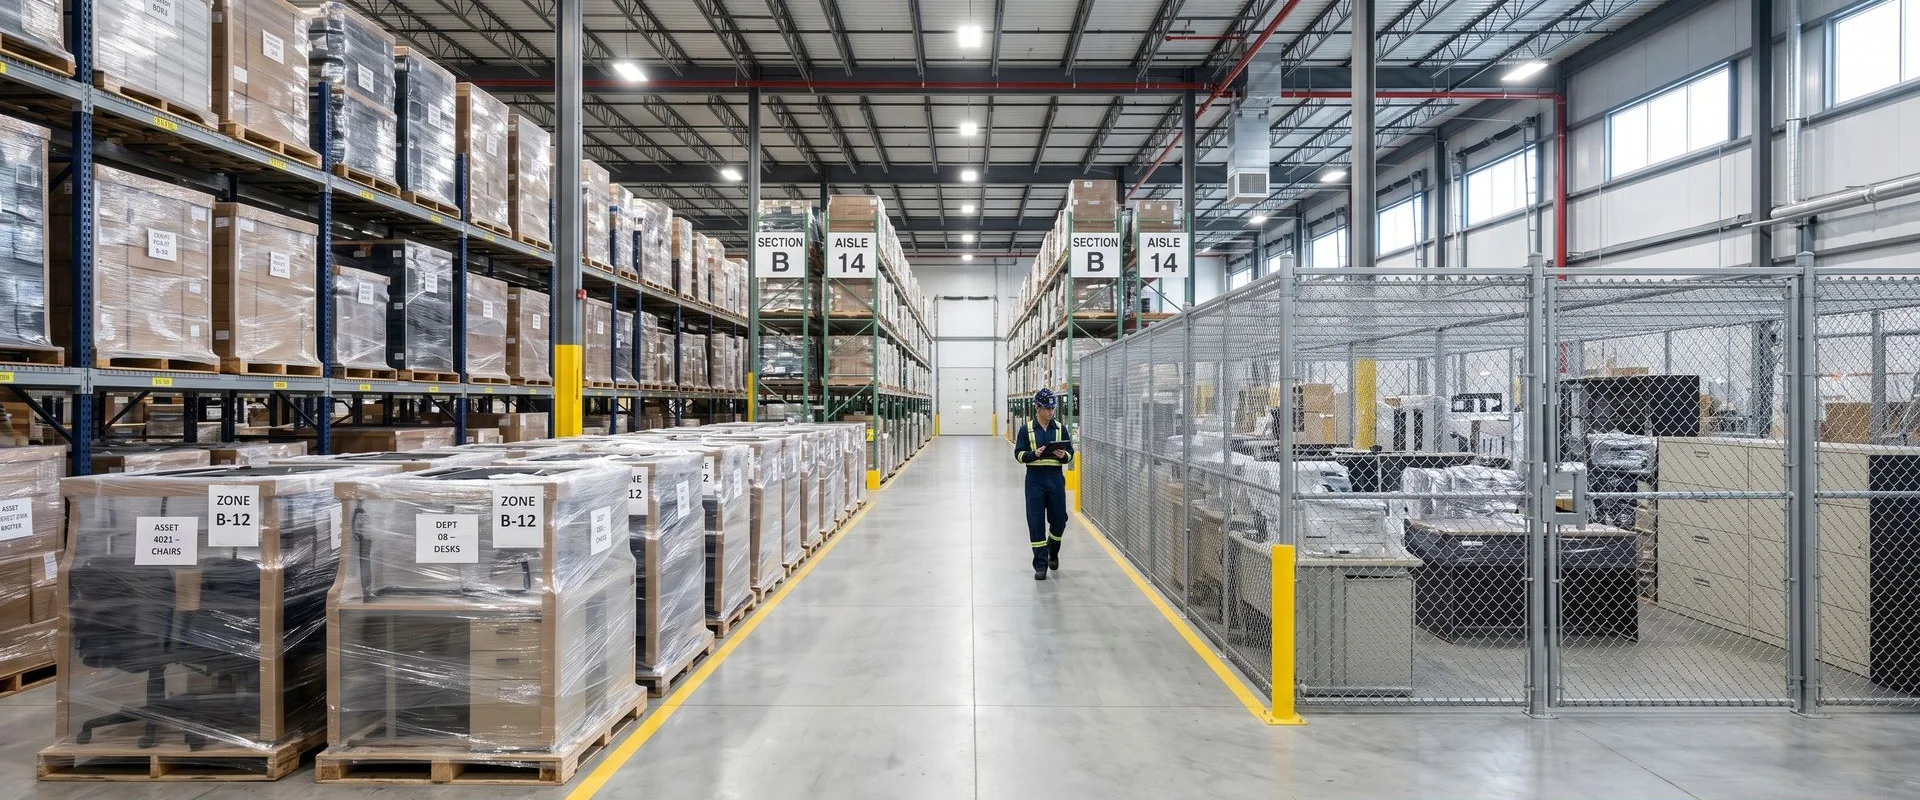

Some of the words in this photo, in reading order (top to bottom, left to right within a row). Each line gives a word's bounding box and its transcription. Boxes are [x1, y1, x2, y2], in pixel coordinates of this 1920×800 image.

[758, 237, 803, 248] SECTION
[835, 237, 869, 248] AISLE
[1073, 237, 1119, 248] SECTION
[1147, 237, 1181, 248] AISLE
[772, 251, 790, 272] B
[838, 252, 866, 273] 14
[1087, 251, 1105, 272] B
[1151, 252, 1178, 273] 14
[628, 489, 642, 499] 12
[217, 495, 251, 506] ZONE
[501, 496, 536, 507] ZONE
[1, 504, 19, 513] ASSET
[216, 513, 251, 526] B-12
[435, 521, 458, 529] DEPT
[501, 514, 537, 528] B-12
[154, 523, 179, 532] ASSET
[153, 536, 173, 544] 4021
[437, 533, 448, 541] 08
[151, 547, 181, 556] CHAIRS
[434, 545, 461, 553] DESKS
